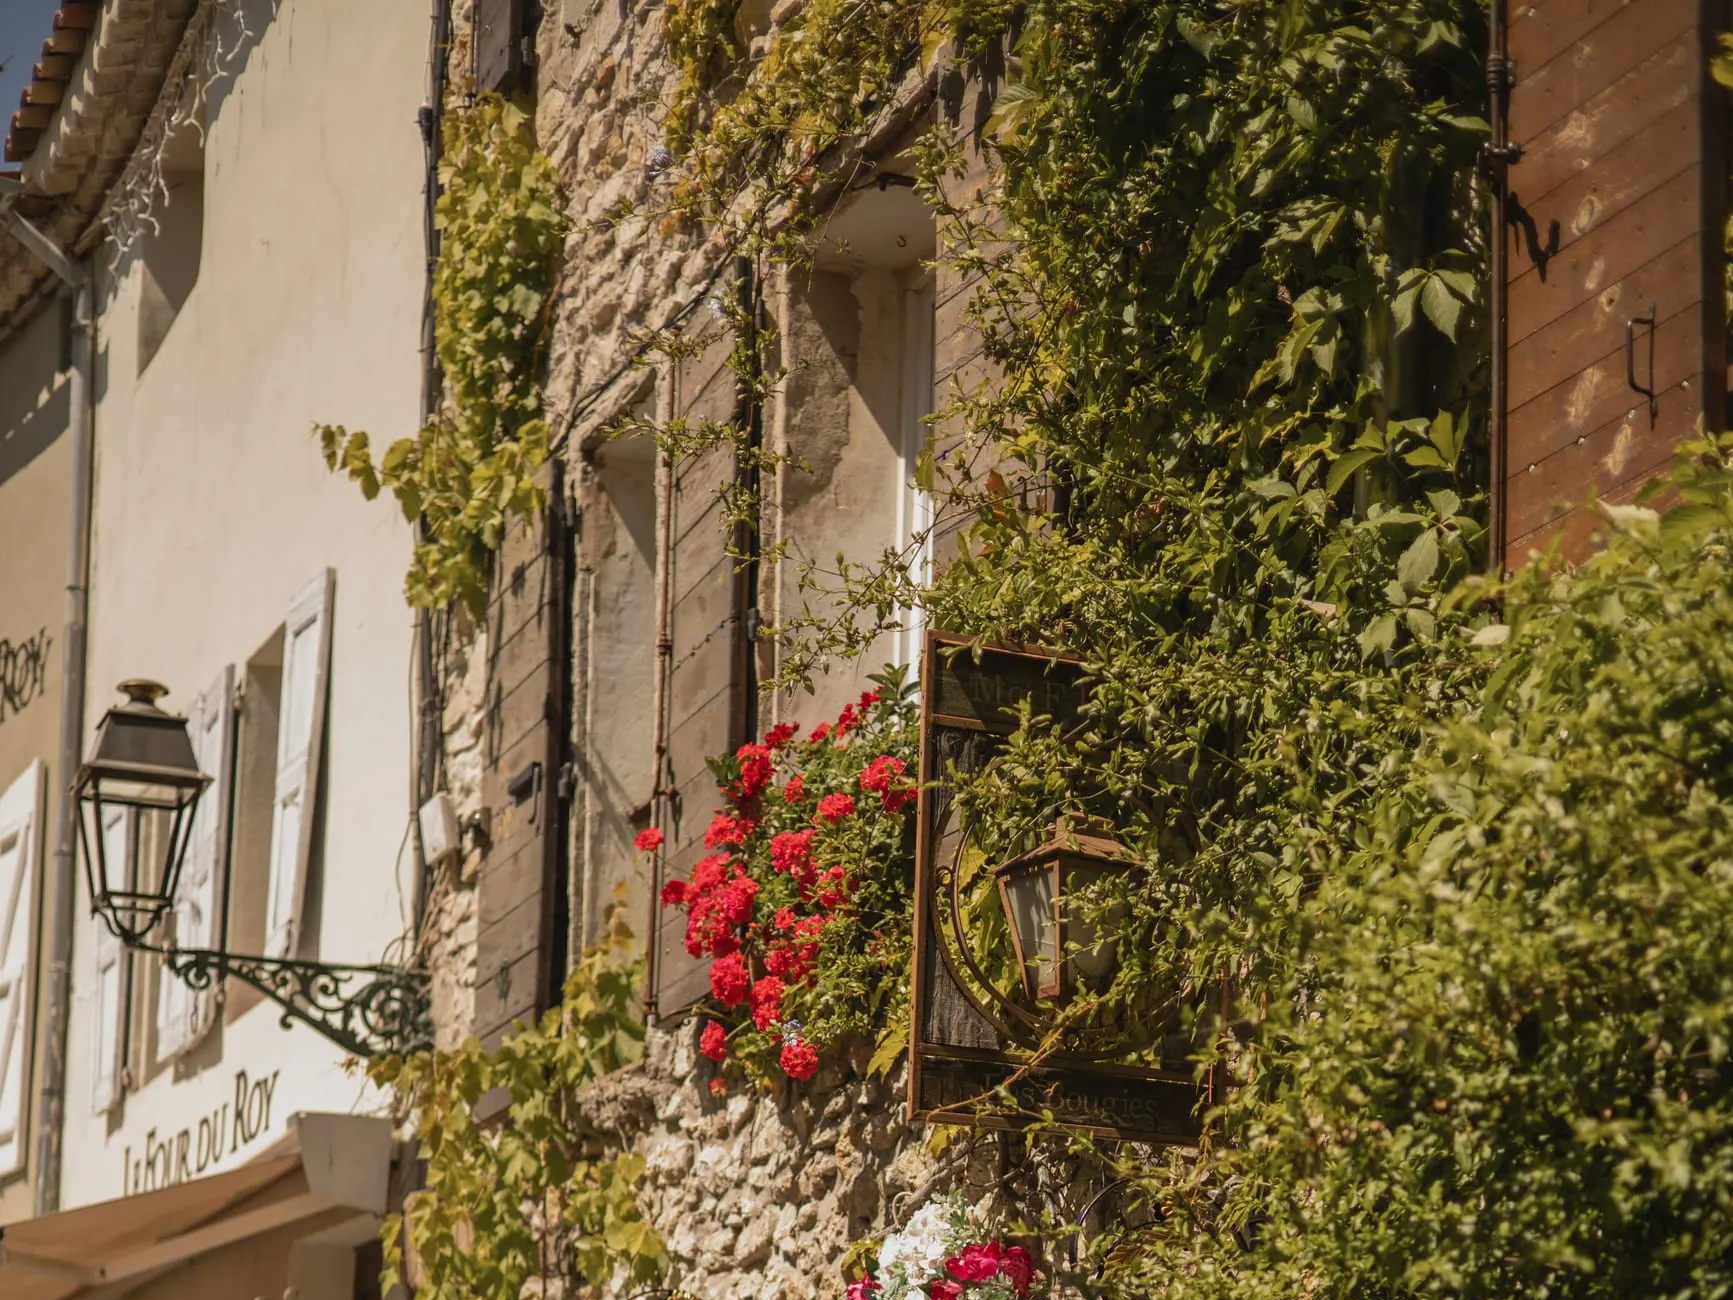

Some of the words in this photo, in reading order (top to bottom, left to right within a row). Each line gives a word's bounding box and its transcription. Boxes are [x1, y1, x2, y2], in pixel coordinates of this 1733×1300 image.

[145, 1128, 192, 1193] FOUR
[197, 1103, 229, 1173] DU
[231, 1069, 279, 1153] ROY
[1040, 1080, 1159, 1127] Bougies
